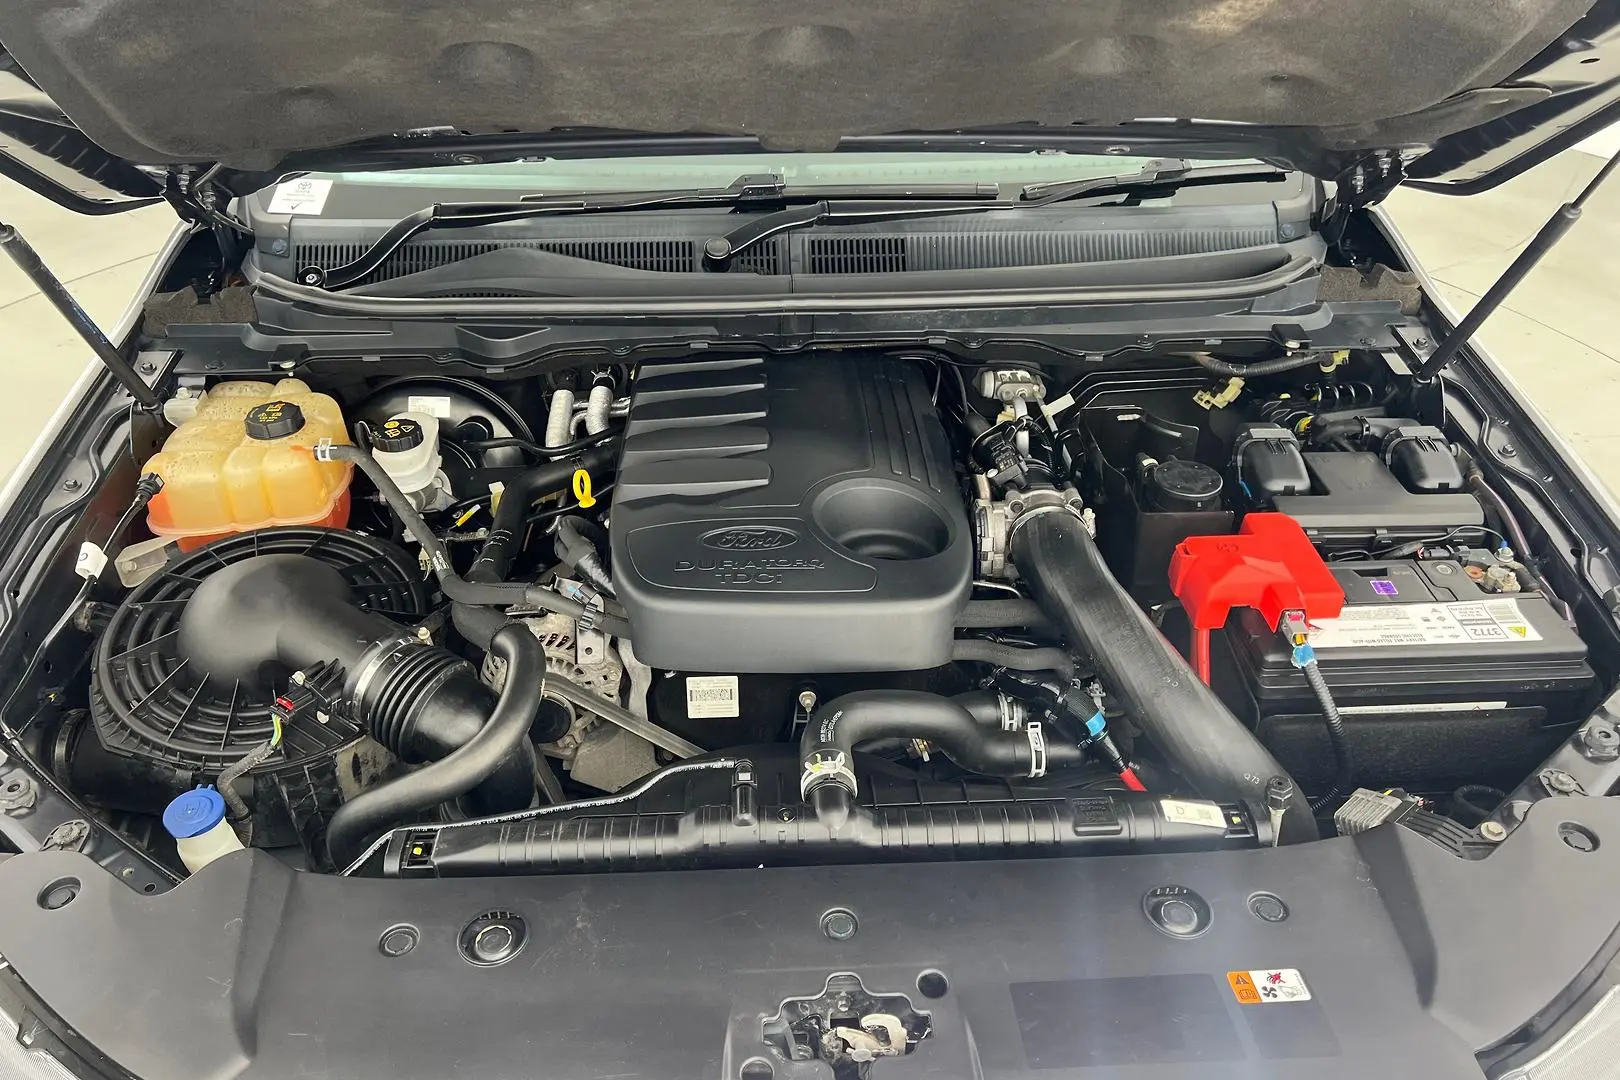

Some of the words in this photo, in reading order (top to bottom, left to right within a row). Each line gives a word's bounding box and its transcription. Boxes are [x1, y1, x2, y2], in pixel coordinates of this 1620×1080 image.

[717, 530, 783, 548] Ford
[674, 558, 825, 572] DURATORQ
[1470, 628, 1501, 636] 3772
